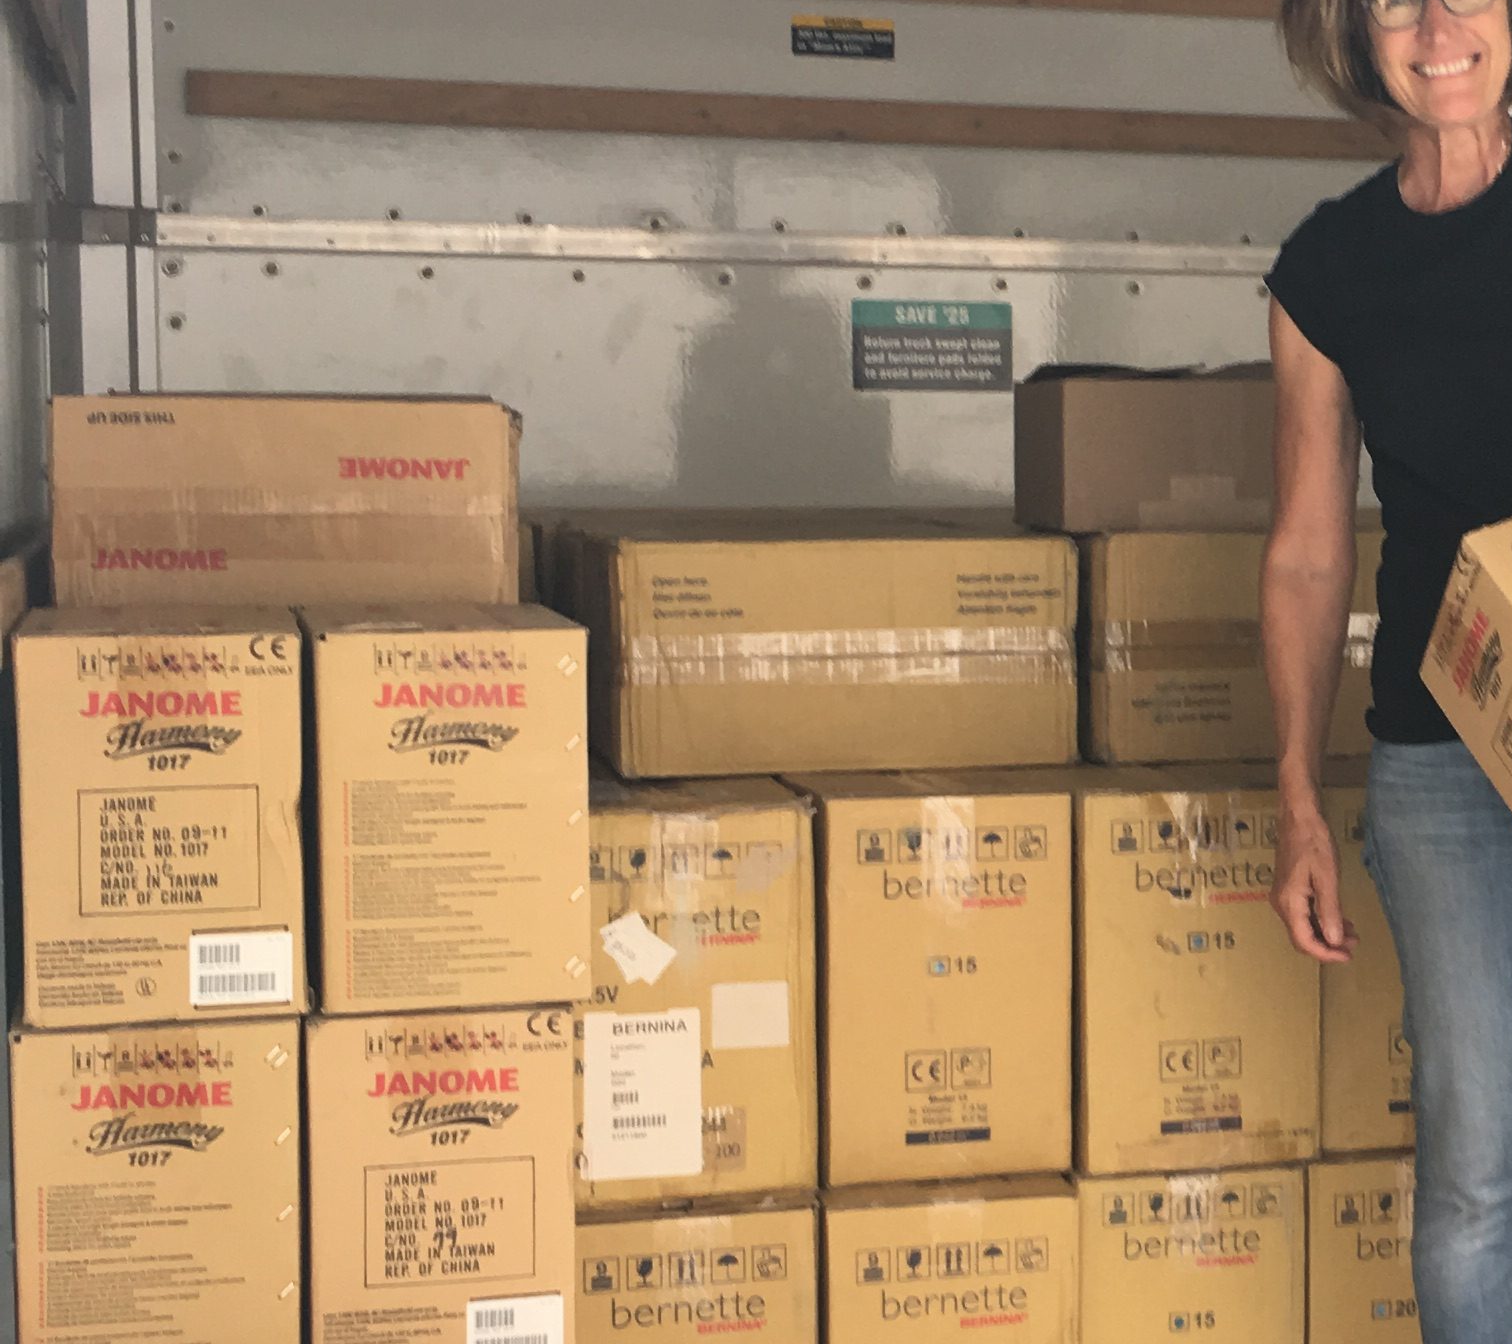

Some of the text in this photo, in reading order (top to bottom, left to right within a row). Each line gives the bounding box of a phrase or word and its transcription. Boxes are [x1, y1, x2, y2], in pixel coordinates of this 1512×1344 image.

[895, 304, 937, 325] SAVE
[338, 455, 471, 481] JANOME
[91, 547, 229, 572] JANOME
[80, 689, 244, 718] JANOME
[373, 681, 528, 710] JANOME
[103, 717, 243, 761] Harmony
[387, 709, 520, 754] Harmony
[147, 753, 192, 771] 1017
[428, 748, 470, 766] 1017
[99, 795, 157, 813] JANOME
[100, 827, 145, 843] ORDER
[100, 843, 147, 858] MODEL
[180, 842, 209, 858] 1017
[100, 872, 219, 891] MADE IN TAIWAN
[882, 868, 1028, 901] bernette
[1135, 860, 1274, 893] bernette
[136, 891, 152, 905] OF
[160, 889, 203, 905] CHINA
[1214, 931, 1236, 949] 15
[955, 956, 978, 974] 15
[612, 1018, 689, 1036] BERNINA
[367, 1067, 520, 1098] JANOME
[71, 1080, 234, 1112] JANOME
[389, 1094, 520, 1138] Harmony
[85, 1111, 225, 1157] Harmony
[430, 1128, 472, 1147] 1017
[126, 1150, 173, 1168] 1017
[384, 1169, 438, 1187] JANOME
[384, 1202, 427, 1218] ORDER
[384, 1216, 427, 1232] MODEL
[461, 1212, 487, 1229] 1017
[384, 1241, 497, 1262] MADE IN TAIWAN
[1123, 1227, 1262, 1261] bernette
[418, 1260, 433, 1276] OF
[440, 1259, 481, 1275] CHINA
[610, 1292, 767, 1331] bernette
[880, 1284, 1029, 1321] bernette
[1195, 1311, 1216, 1329] 15
